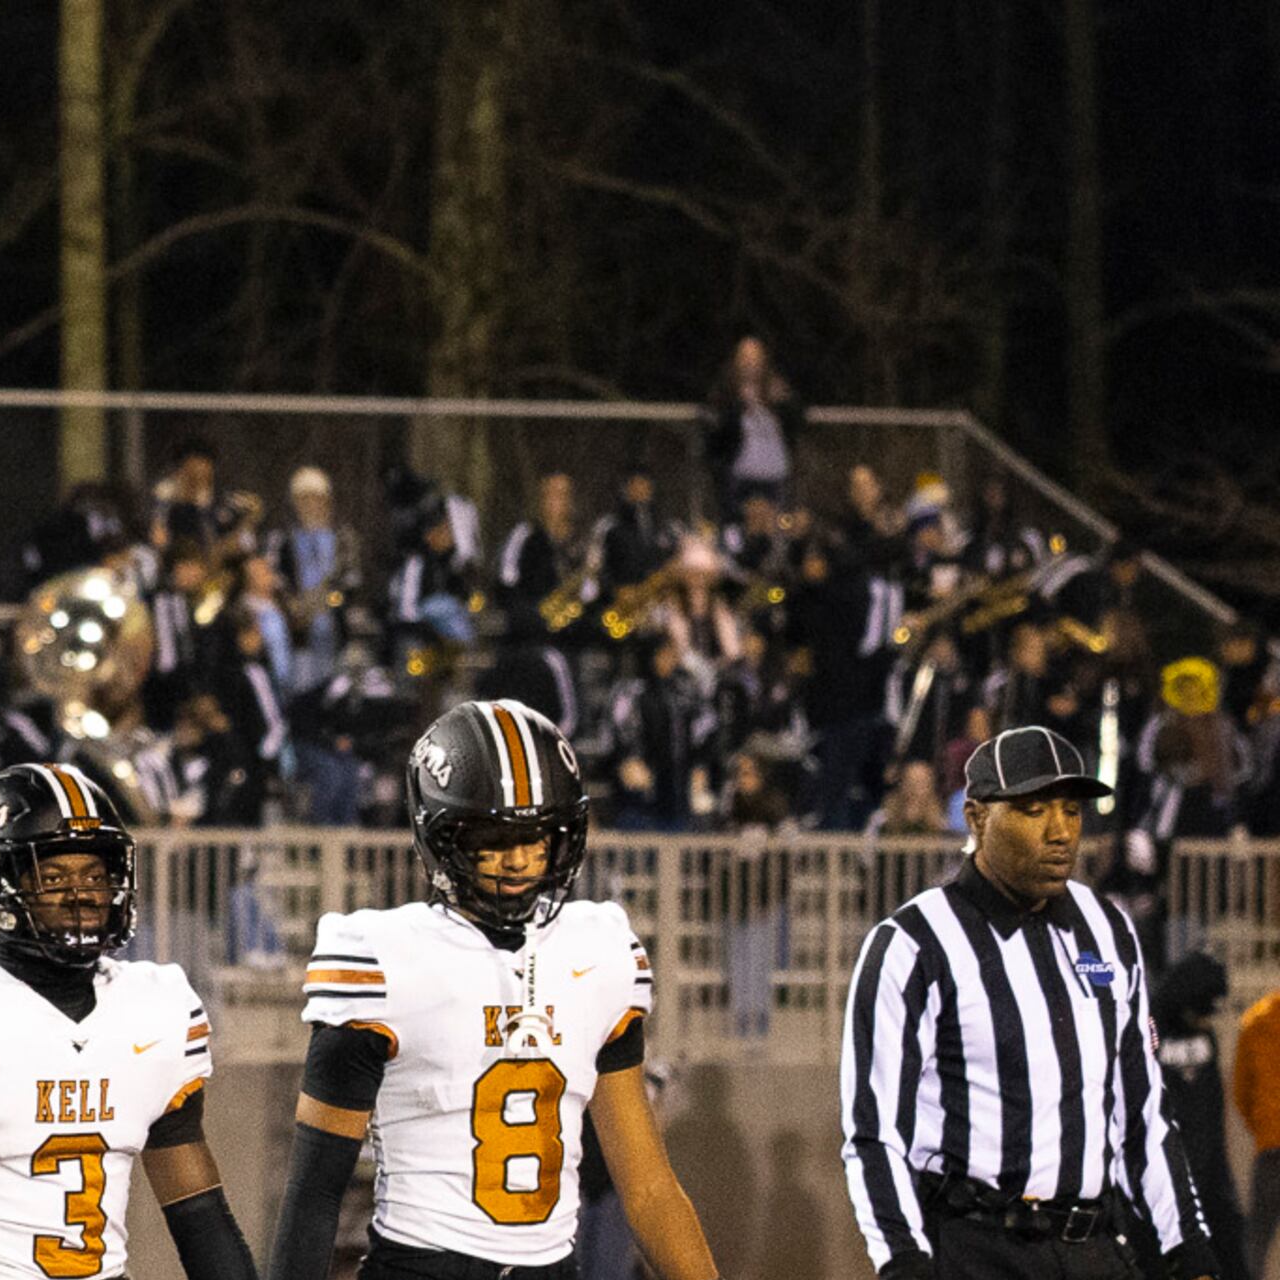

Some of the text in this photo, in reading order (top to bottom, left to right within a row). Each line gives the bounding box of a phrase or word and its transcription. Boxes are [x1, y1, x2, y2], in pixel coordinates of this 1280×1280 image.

[35, 1078, 115, 1123] KELL
[470, 1057, 568, 1225] 8
[31, 1132, 110, 1280] 3
